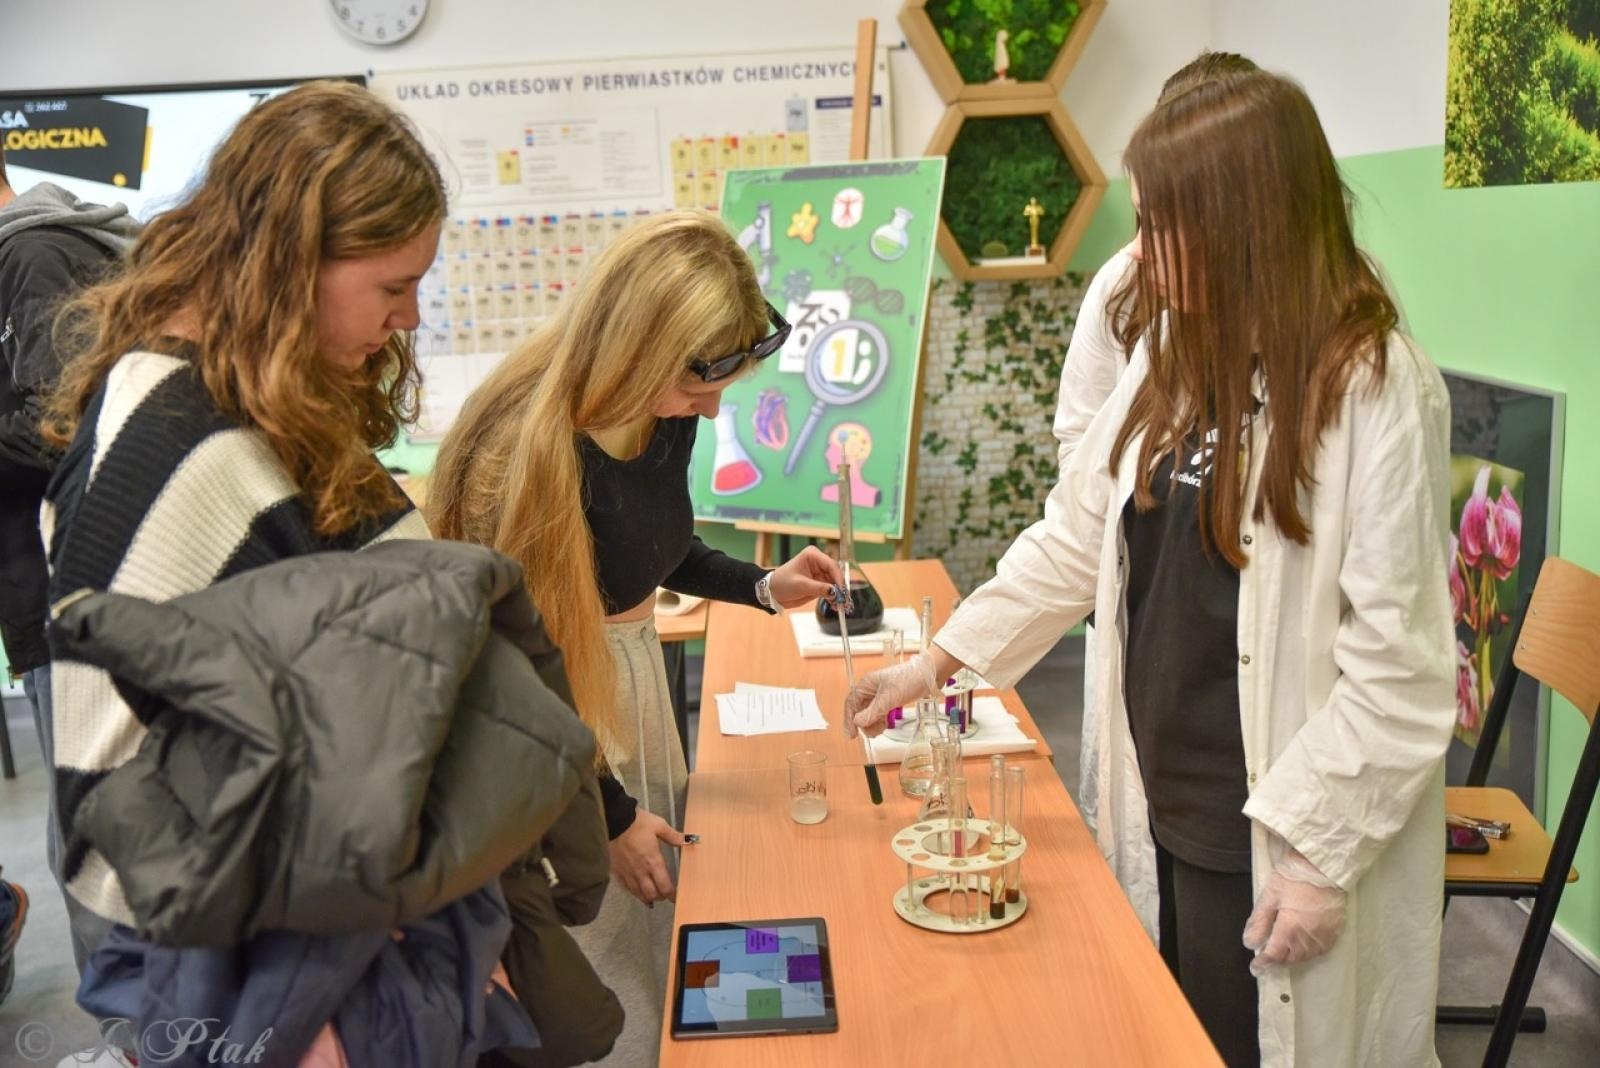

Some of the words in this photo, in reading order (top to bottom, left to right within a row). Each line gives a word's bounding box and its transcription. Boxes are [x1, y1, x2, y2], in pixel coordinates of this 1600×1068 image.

[397, 82, 460, 101] UKŁAD
[468, 76, 574, 97] OKRESOWY
[583, 64, 724, 91] PIERWIASTKÓW
[0, 110, 29, 128] SA
